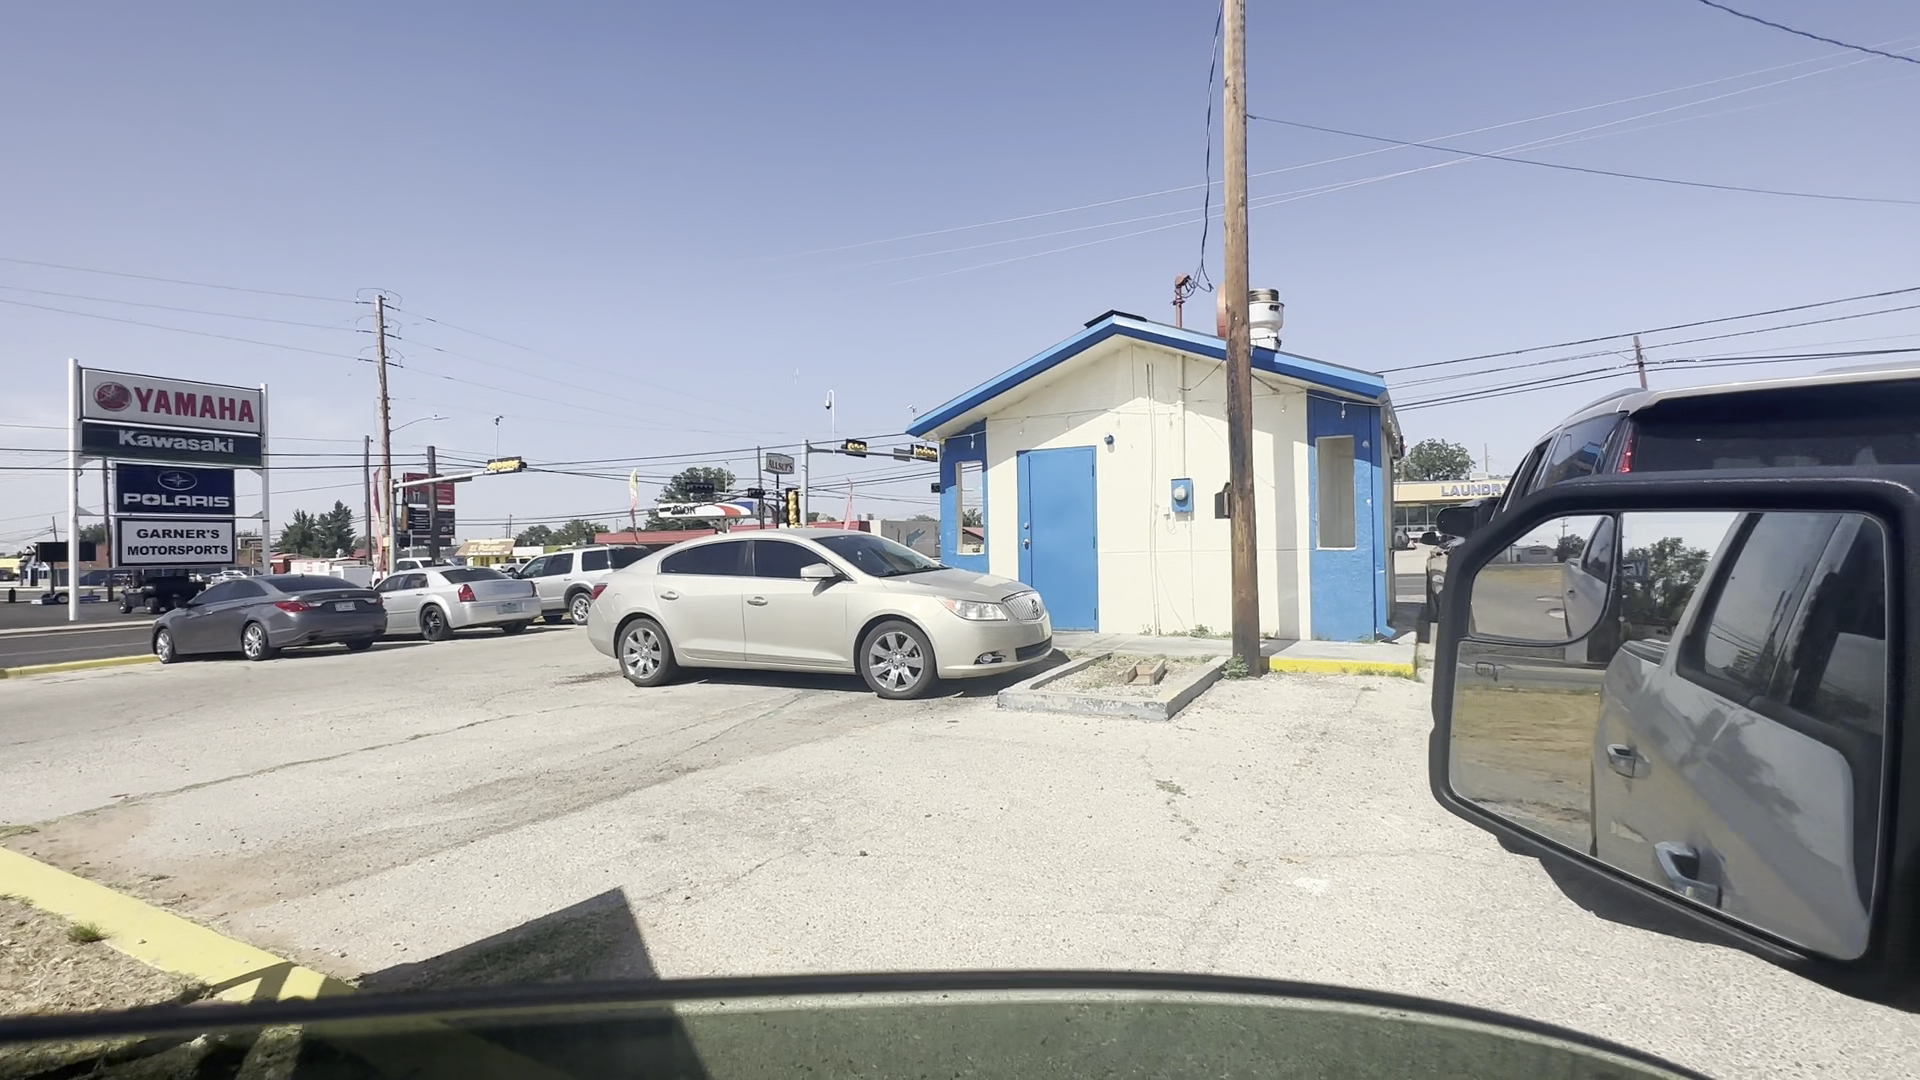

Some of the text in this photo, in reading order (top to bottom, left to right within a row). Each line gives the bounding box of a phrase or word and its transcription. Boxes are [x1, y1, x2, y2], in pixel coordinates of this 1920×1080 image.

[133, 387, 255, 423] YAMAHA
[118, 429, 234, 453] Kawasaki
[123, 492, 230, 508] POLARIS
[136, 528, 220, 539] GARNER'S
[127, 545, 228, 556] MOTORSPORTS
